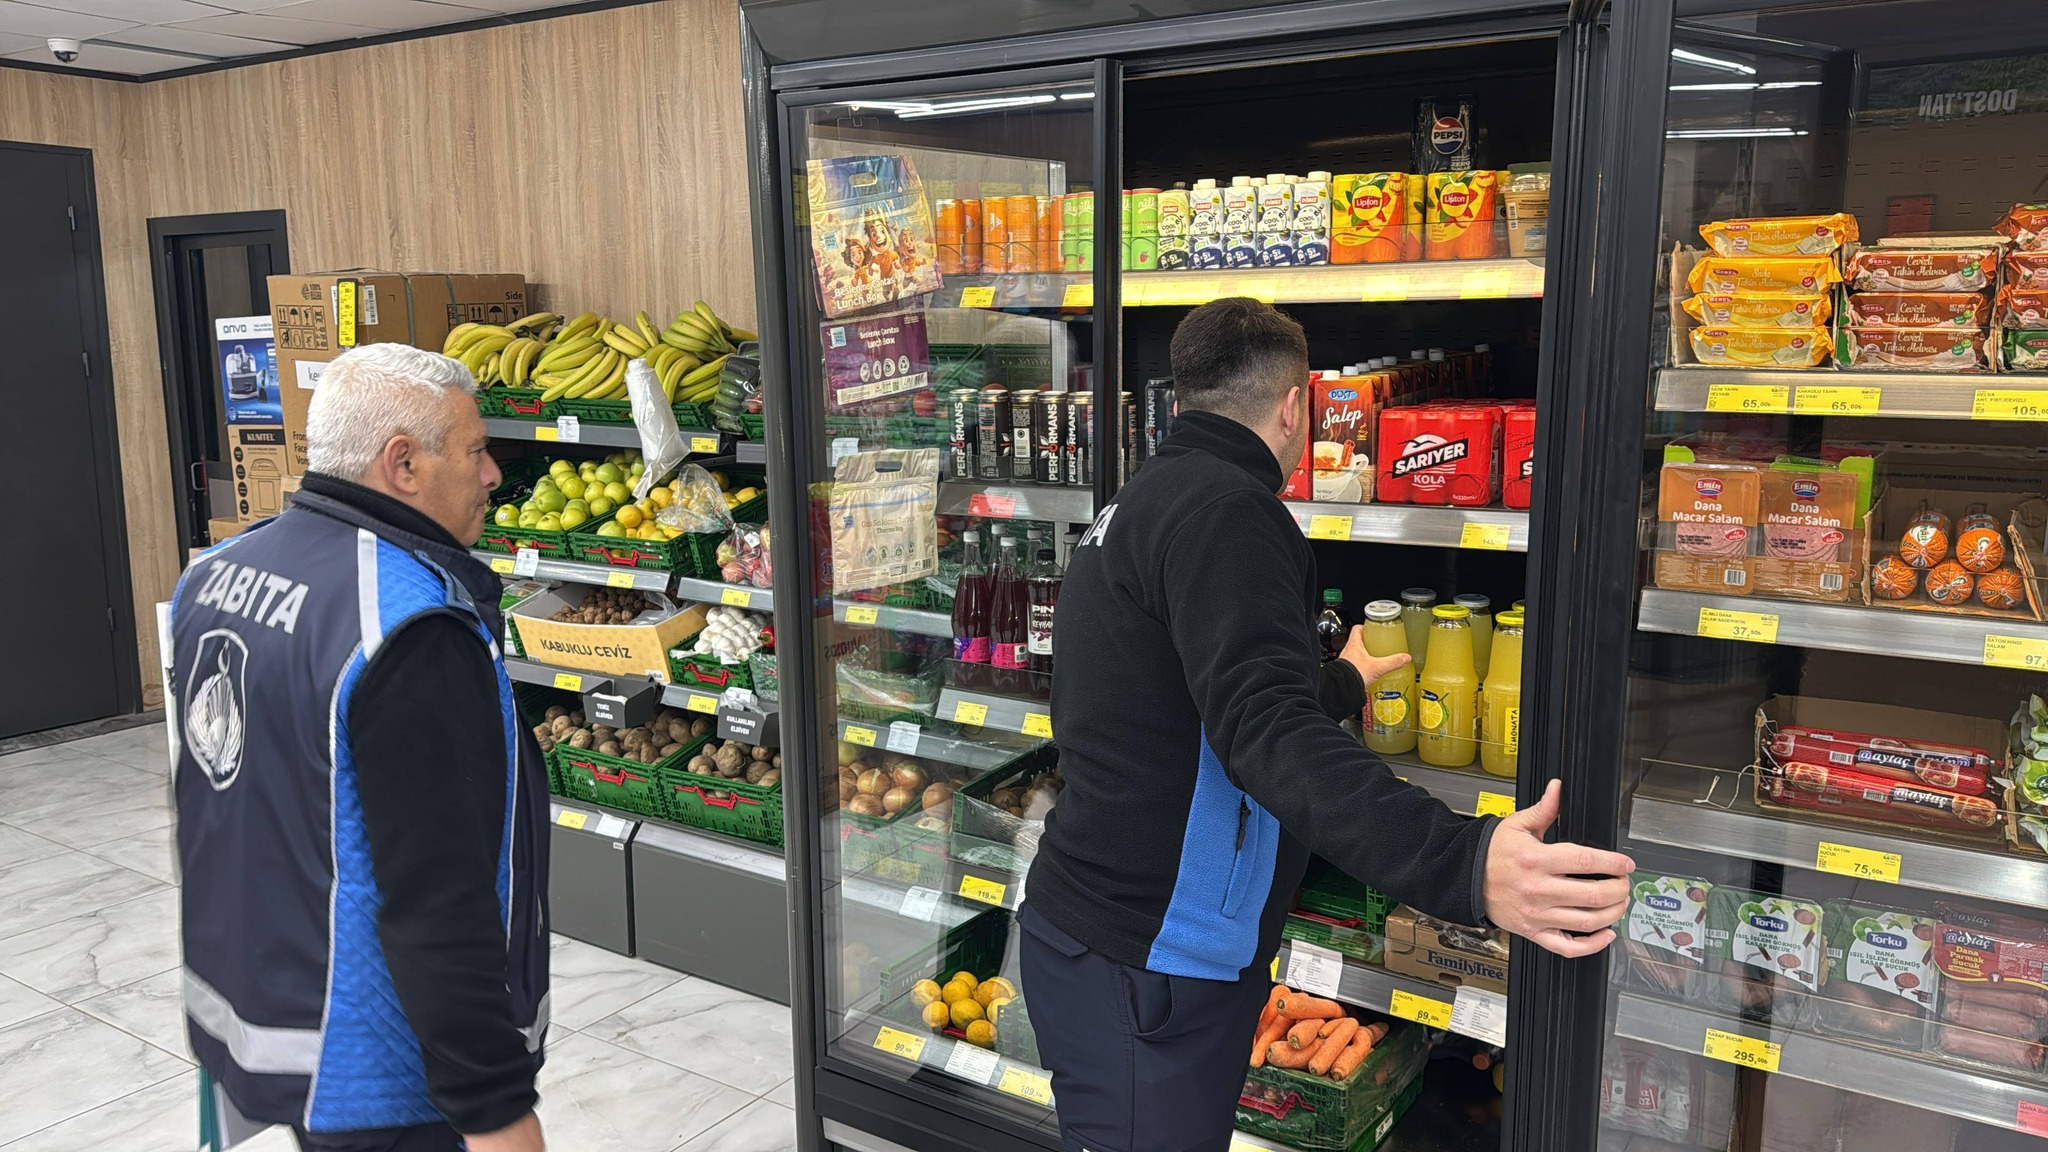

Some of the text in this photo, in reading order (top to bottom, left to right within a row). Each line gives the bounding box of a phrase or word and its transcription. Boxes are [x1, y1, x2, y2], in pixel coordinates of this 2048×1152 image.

[1433, 131, 1463, 140] PEPSI
[1356, 198, 1379, 209] Lipton
[1444, 195, 1466, 204] Lipton
[1264, 217, 1279, 225] COOL
[1299, 215, 1315, 223] COOL
[1891, 266, 1915, 277] Tahin
[505, 291, 523, 300] Side
[835, 295, 865, 310] Lunch
[1885, 313, 1908, 323] Tahin
[1882, 341, 1906, 352] Tahin
[1331, 389, 1354, 400] DOST
[1322, 403, 1364, 430] Salep
[247, 433, 275, 442] KUMTEL
[1394, 441, 1466, 476] SARIYER
[1413, 474, 1446, 484] KOLA
[1696, 481, 1721, 490] Emin
[1793, 482, 1818, 492] Emin
[1694, 500, 1722, 512] Dana
[1790, 502, 1819, 514] Dana
[1672, 511, 1743, 525] Macar Salam
[1768, 513, 1841, 528] Macar Salam
[194, 558, 309, 635] ZABITA
[540, 638, 632, 659] KABUKLU CEVİZ
[1509, 709, 1518, 753] LIMONATA
[1648, 896, 1677, 909] Torku
[1753, 916, 1784, 930] Torku
[1759, 932, 1778, 940] DANA
[1870, 933, 1902, 947] Torku
[1769, 944, 1791, 953] SUCUK
[1875, 950, 1895, 958] DANA
[1955, 945, 1979, 957] Dana
[1949, 950, 1985, 964] Parmak
[1885, 963, 1909, 972] SUCUK
[1952, 958, 1980, 970] Sucuk
[1707, 1031, 1743, 1043] KASAP SUCUK
